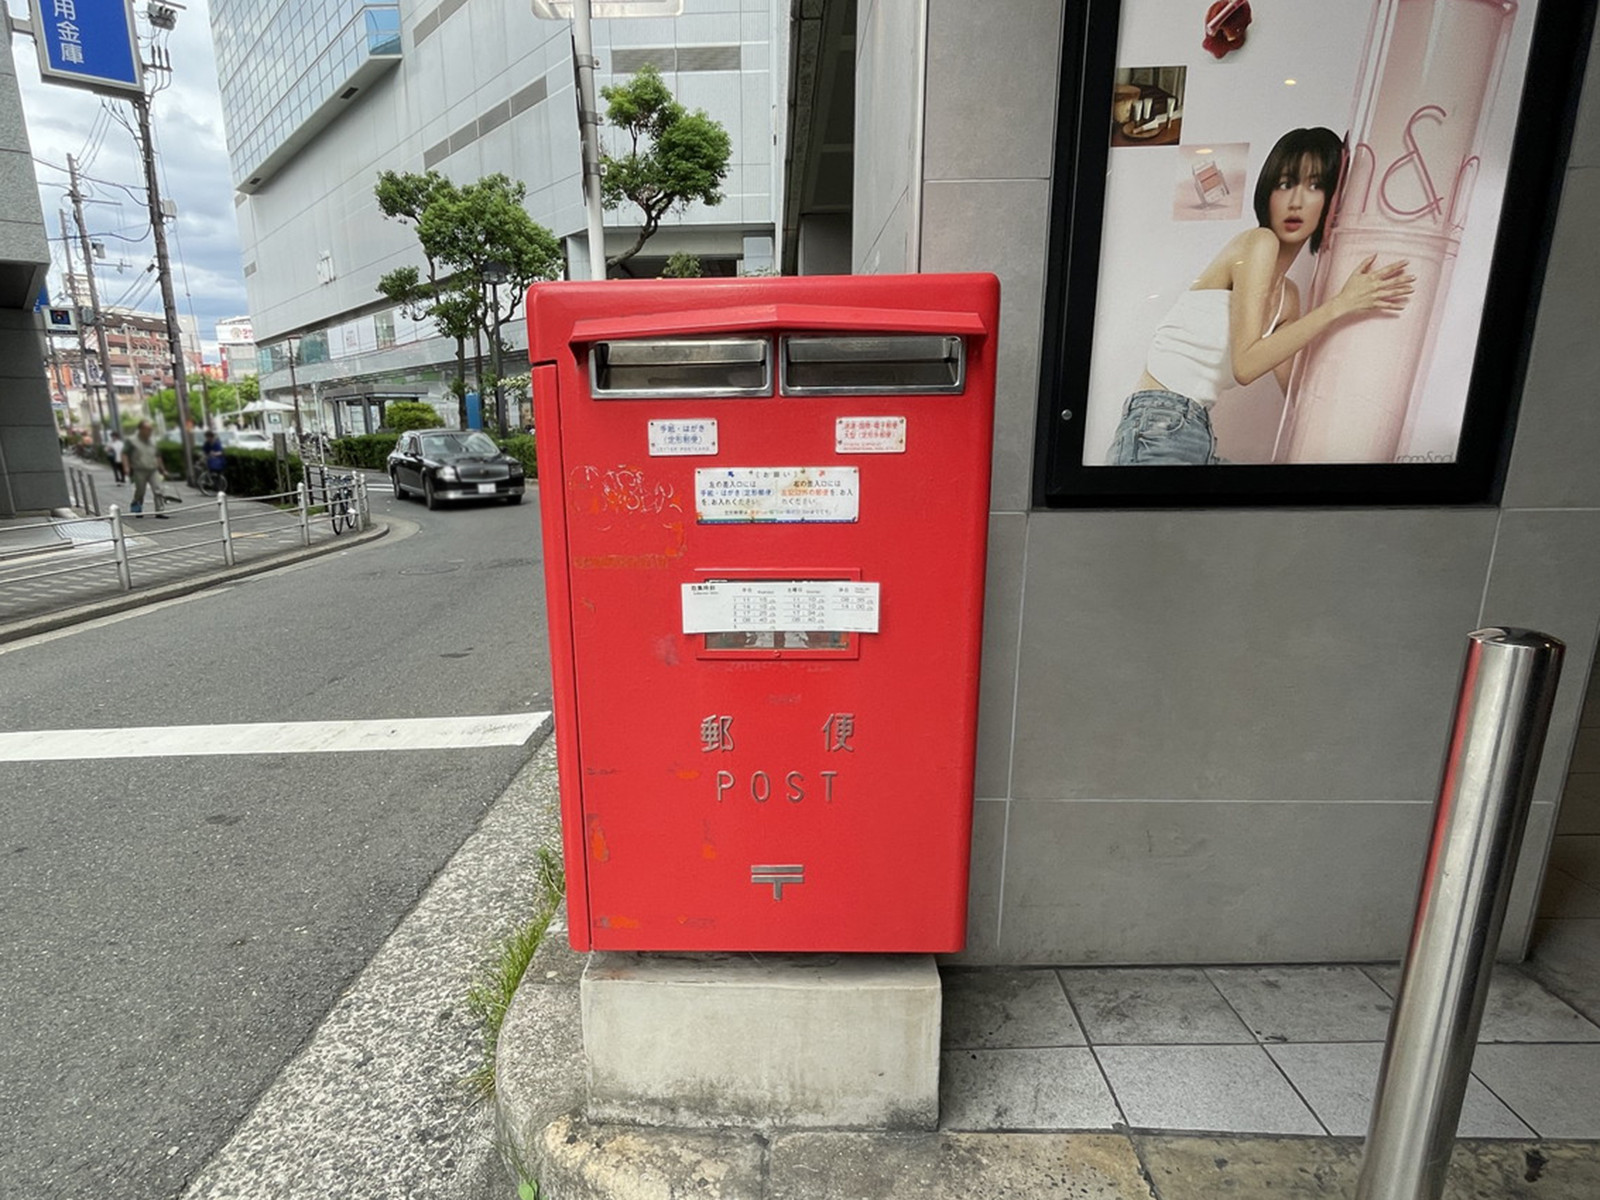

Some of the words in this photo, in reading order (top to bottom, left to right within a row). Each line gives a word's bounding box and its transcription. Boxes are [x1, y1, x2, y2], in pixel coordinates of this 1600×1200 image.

[54, 0, 84, 64] 用金庫
[717, 771, 838, 803] POST
